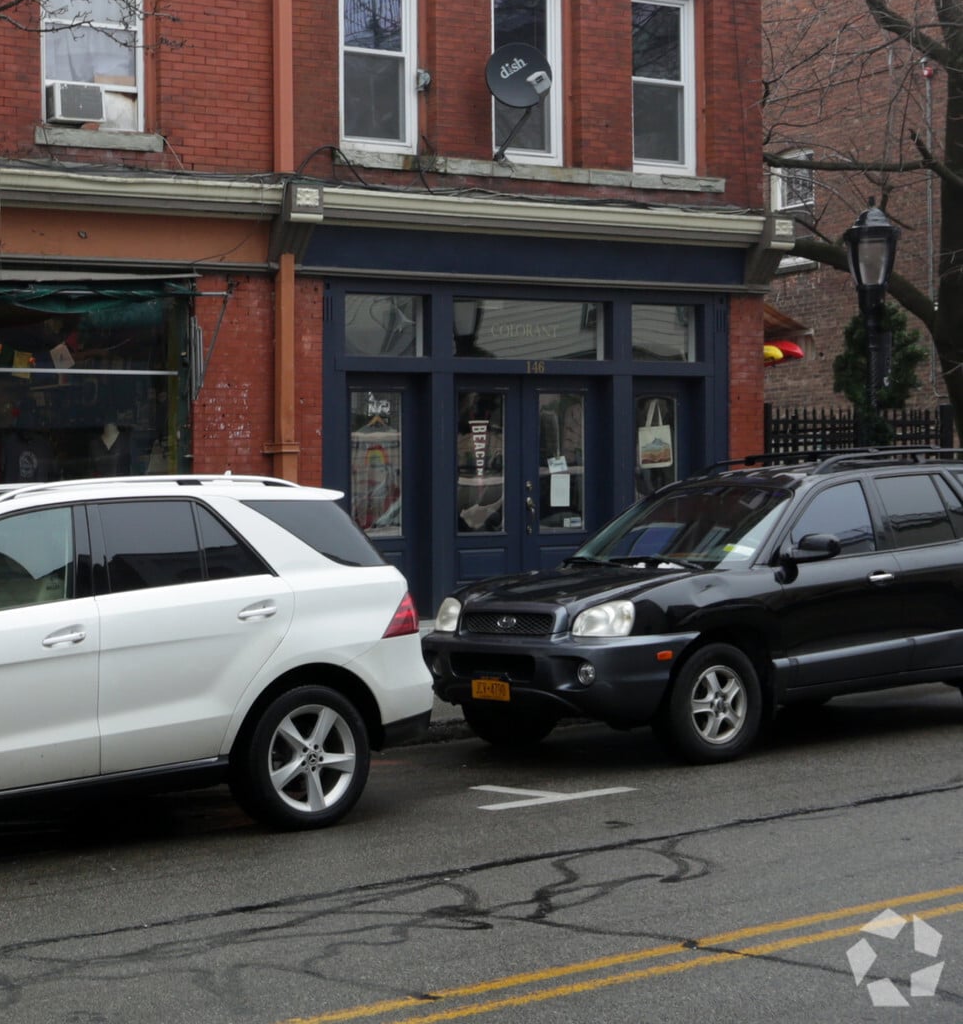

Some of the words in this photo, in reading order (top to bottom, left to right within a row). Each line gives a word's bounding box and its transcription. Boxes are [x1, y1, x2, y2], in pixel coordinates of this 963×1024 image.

[500, 58, 527, 79] dish
[491, 323, 559, 337] COLORANT
[526, 361, 545, 374] 146
[471, 425, 487, 476] BEACON
